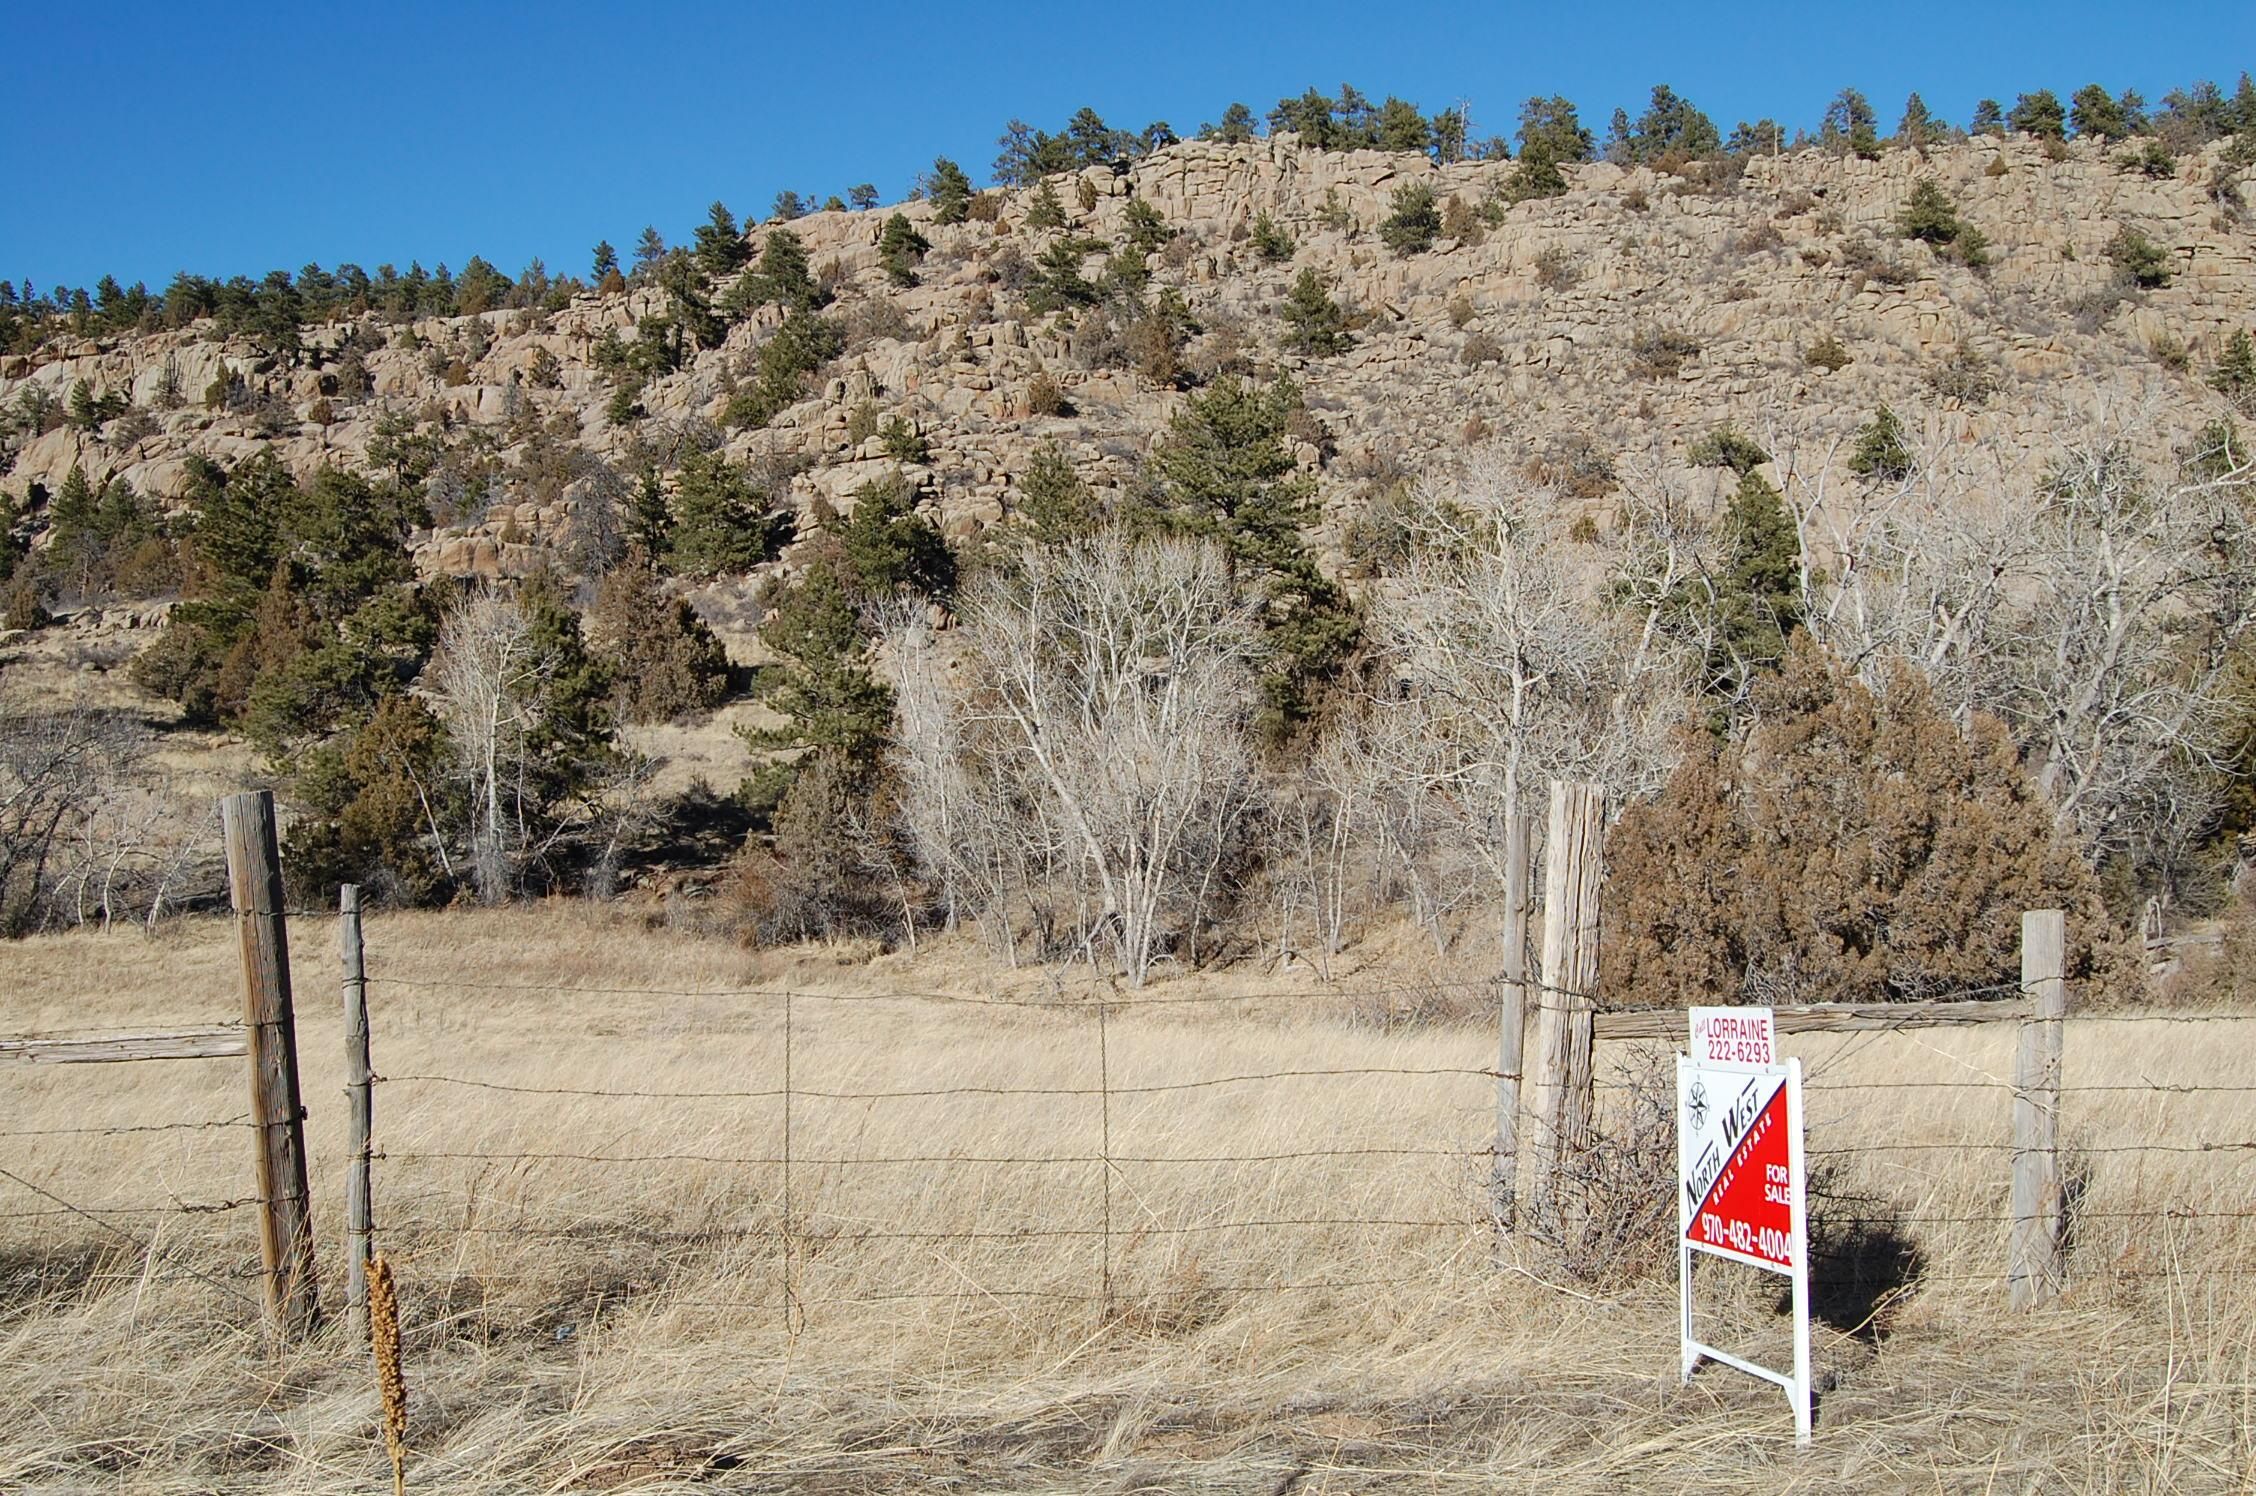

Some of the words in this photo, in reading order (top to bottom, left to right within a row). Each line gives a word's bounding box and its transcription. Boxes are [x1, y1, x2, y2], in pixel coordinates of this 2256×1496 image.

[1706, 1017, 1769, 1041] LORRAINE
[1708, 1040, 1770, 1064] 222-6293
[1712, 1168, 1735, 1206] REAL
[1736, 1112, 1772, 1167] ESTATE
[1685, 1146, 1721, 1216] NORTH
[1765, 1163, 1788, 1184] FOR
[1764, 1183, 1791, 1205] SALE
[1701, 1212, 1793, 1263] 970-482-4004
